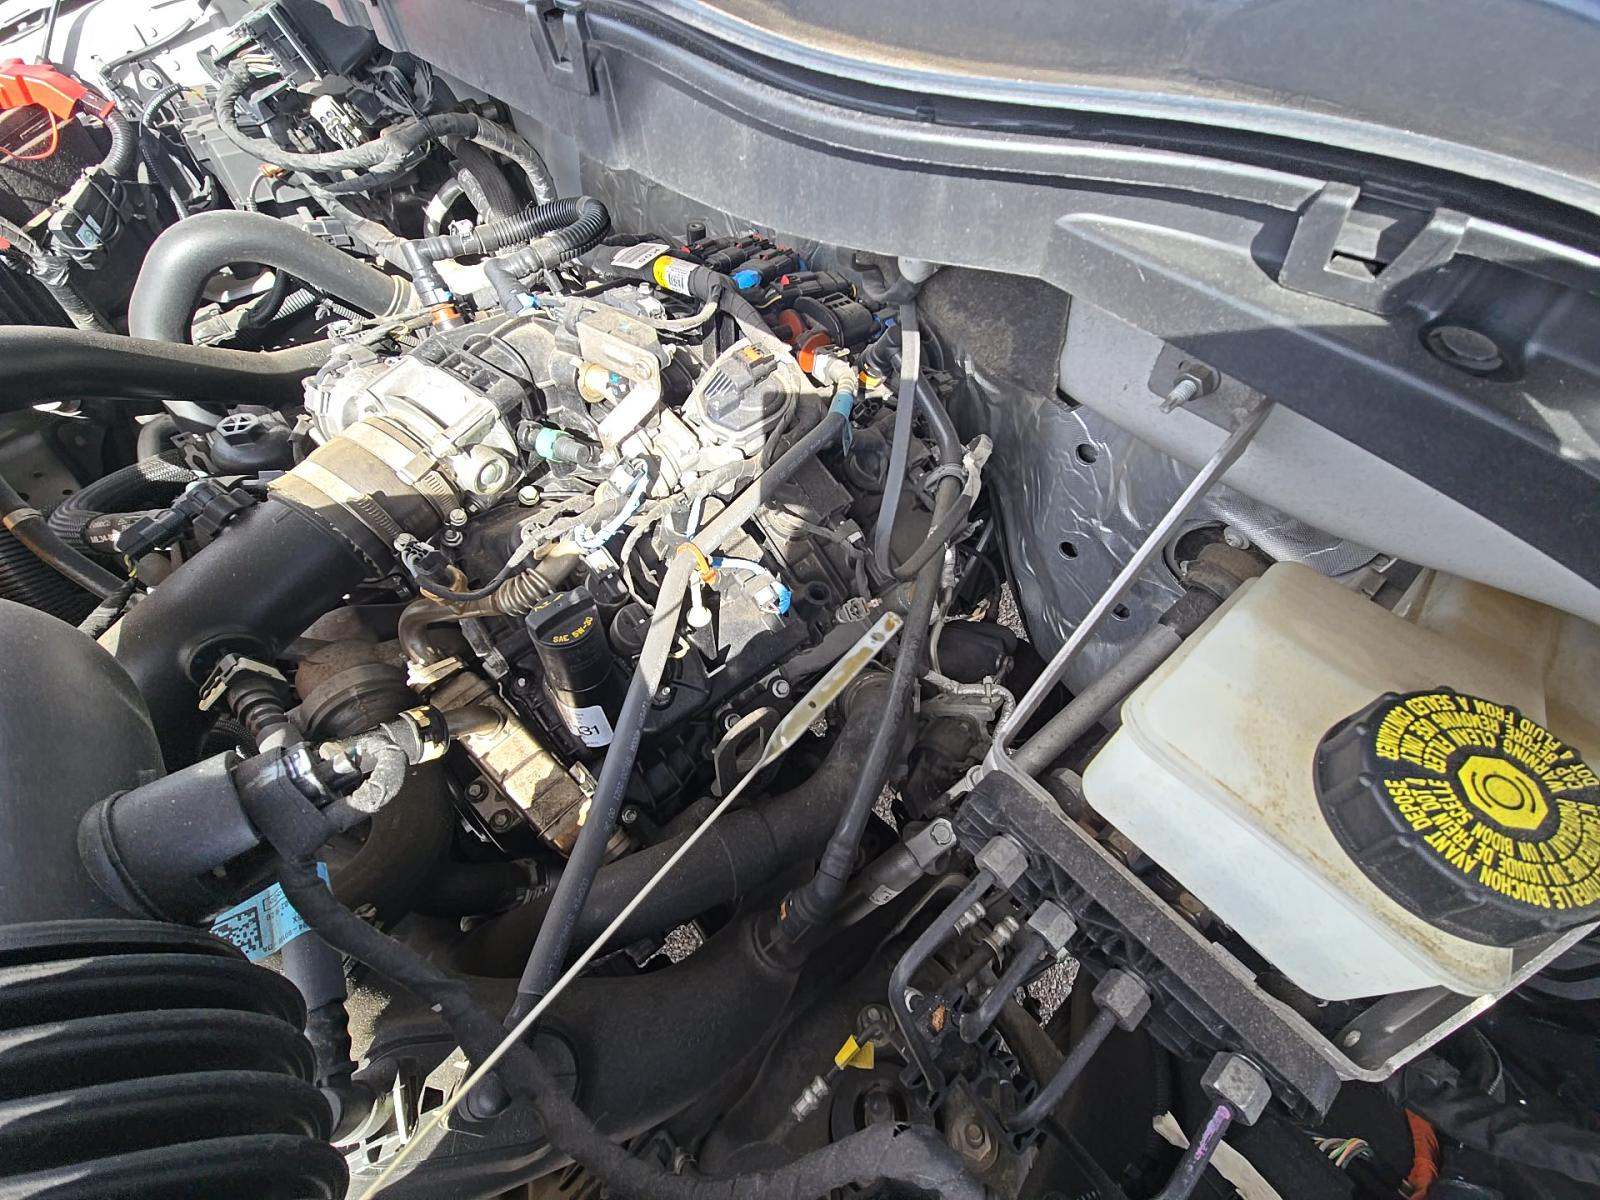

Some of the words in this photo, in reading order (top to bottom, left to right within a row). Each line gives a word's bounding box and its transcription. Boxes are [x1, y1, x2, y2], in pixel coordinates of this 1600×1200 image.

[572, 617, 593, 637] 5W-30
[1405, 694, 1455, 716] SEALED
[1455, 696, 1469, 712] A
[1473, 699, 1514, 725] FROM
[1375, 706, 1415, 761] CONTAINER
[1408, 718, 1439, 740] USE
[1430, 711, 1500, 735] REMOVING
[1519, 718, 1562, 751] FLUID
[1400, 734, 1425, 766] ONLY
[1447, 729, 1496, 749] CLEAN
[1503, 725, 1559, 765] BEFORE
[1423, 734, 1456, 774] FILLER
[1503, 739, 1567, 793] WARNING
[1560, 750, 1575, 761] 4
[1556, 768, 1585, 790] CAP
[1569, 762, 1600, 788] DOT
[1384, 779, 1433, 832] DEPOSE
[1410, 789, 1442, 812] DOT
[1428, 778, 1474, 826] SCELLE
[1431, 812, 1474, 850] FREIN
[1471, 821, 1514, 856] BIDON
[1423, 831, 1478, 874] AVANT
[1472, 842, 1493, 866] DE
[1498, 853, 1550, 886] LIQUIDE
[1479, 865, 1550, 909] BOUCHON
[1549, 886, 1572, 910] LE
